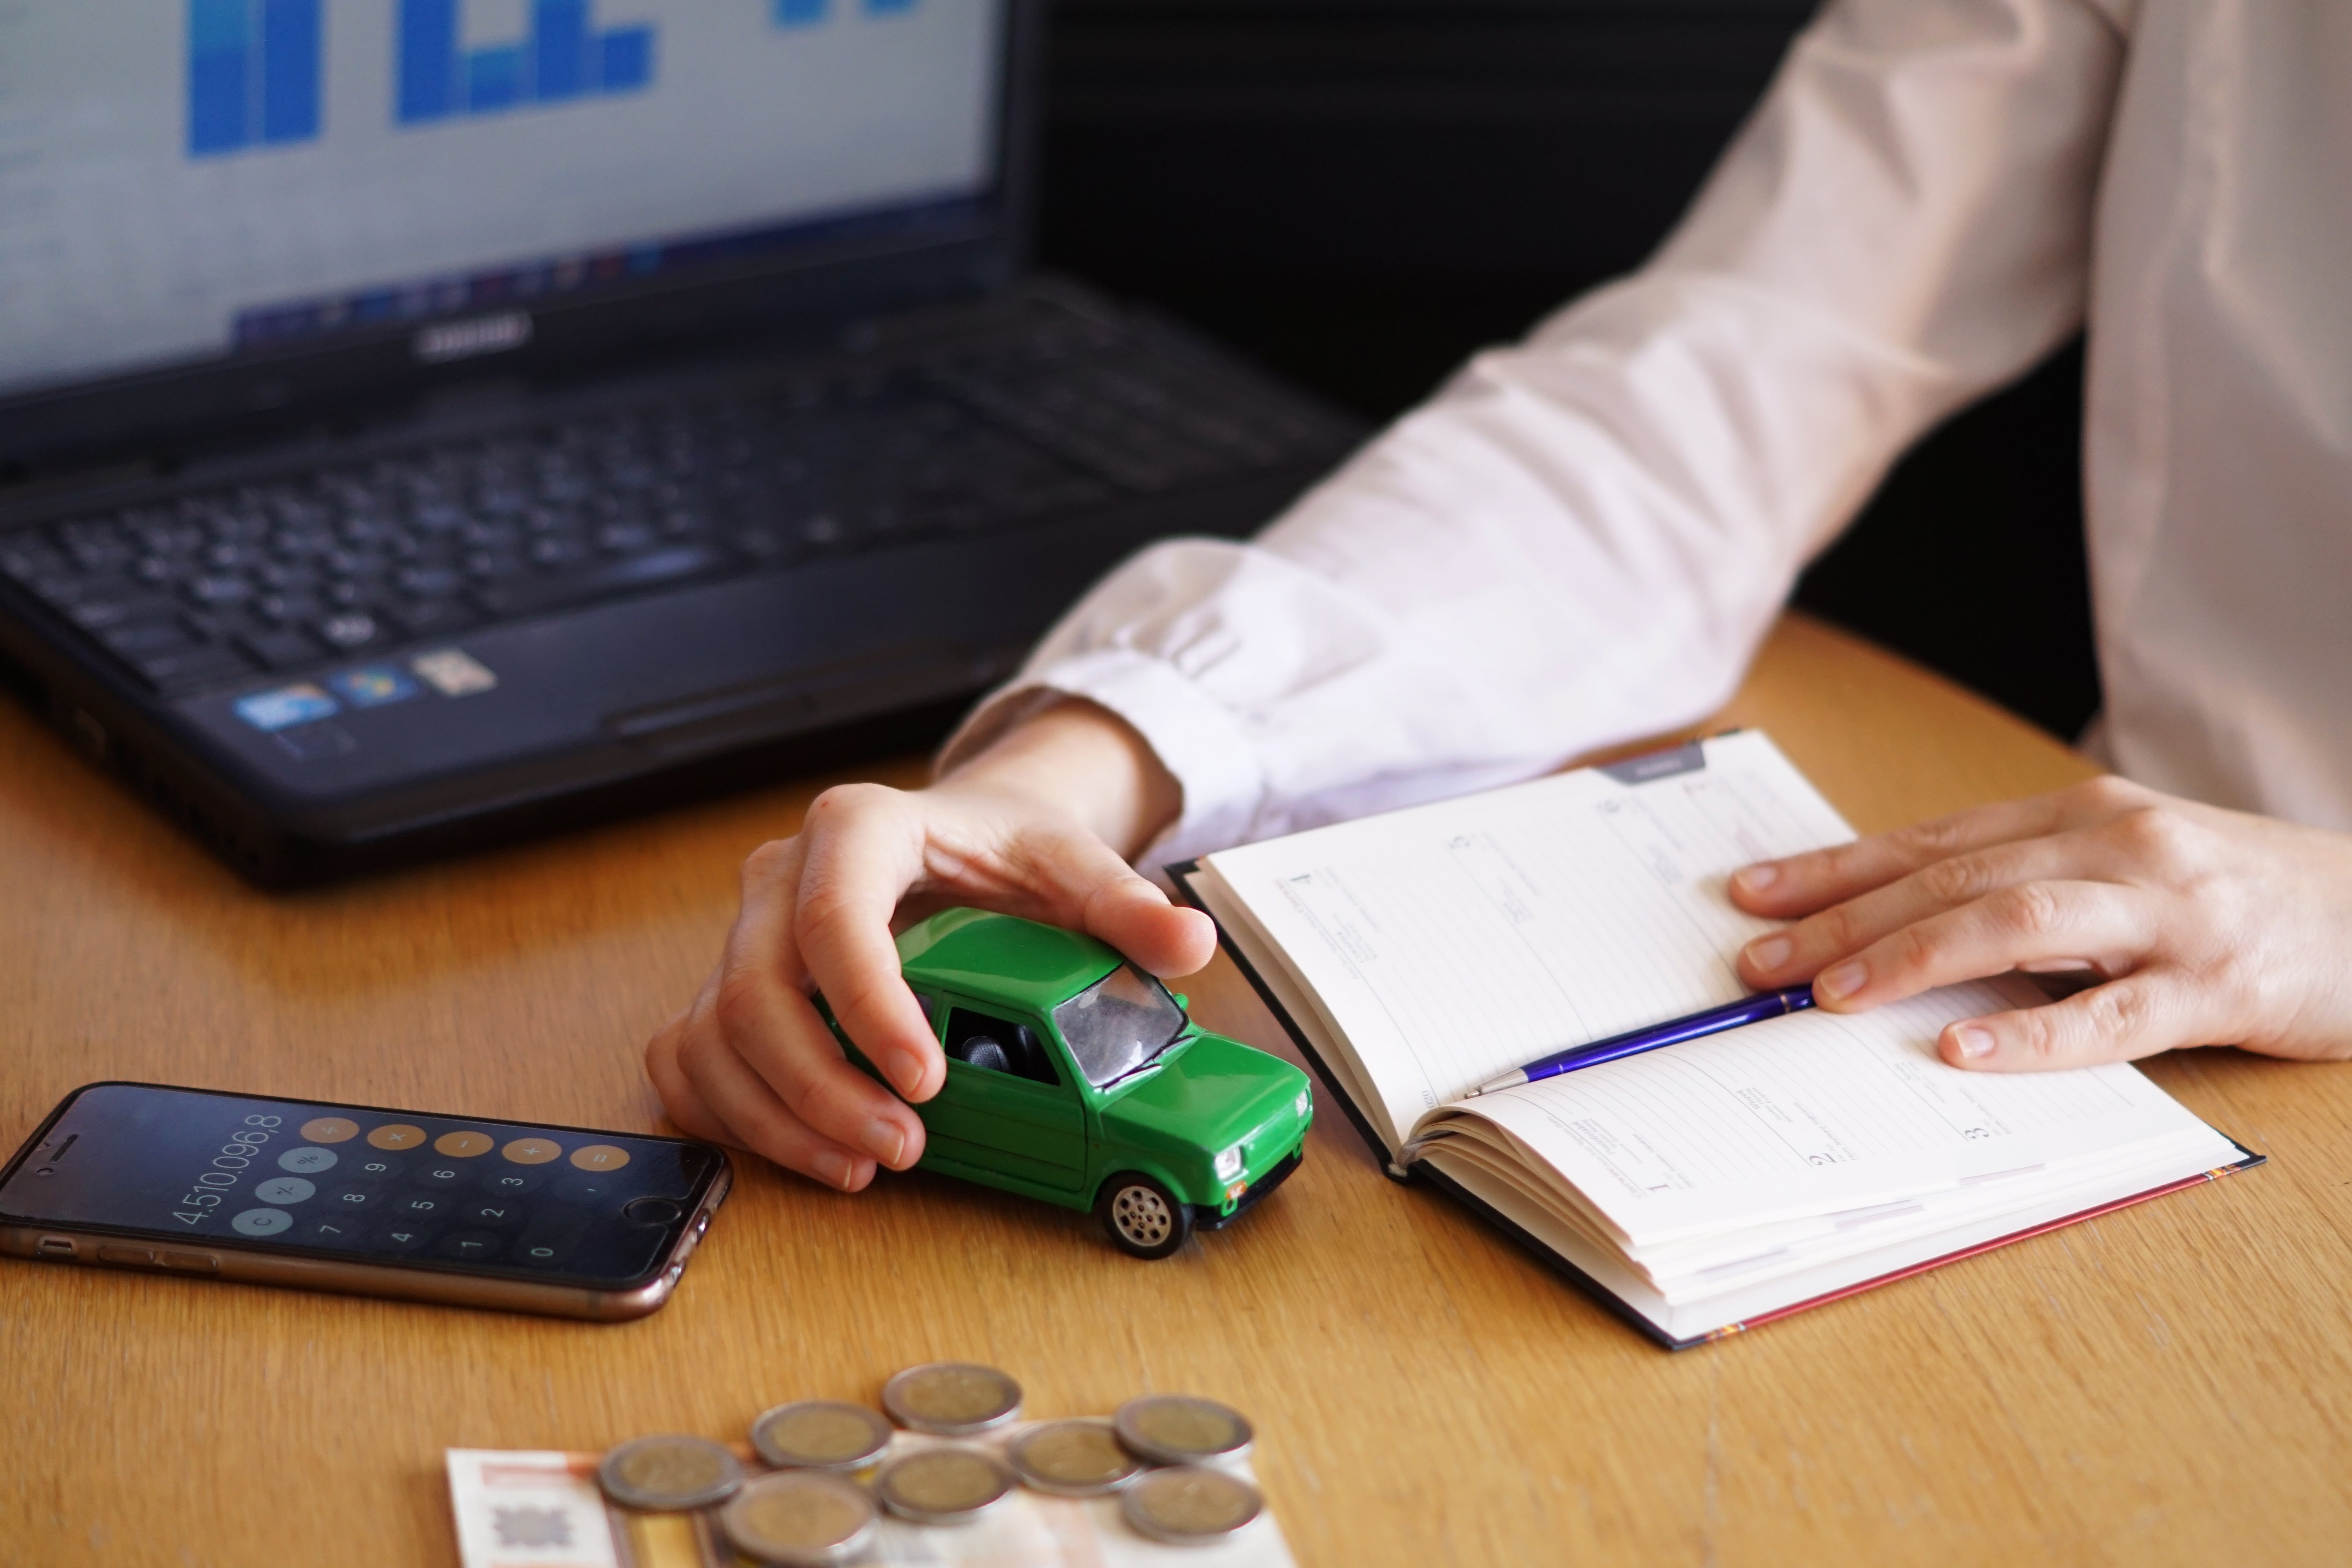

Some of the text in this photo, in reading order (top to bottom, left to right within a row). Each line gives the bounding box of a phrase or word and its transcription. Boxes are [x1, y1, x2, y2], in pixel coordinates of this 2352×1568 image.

[1289, 873, 1311, 885] 4
[1733, 1089, 1763, 1109] Wtorek
[1964, 1127, 1990, 1140] 3
[172, 1114, 282, 1225] 4.510.096,8
[1808, 1152, 1837, 1166] 2
[253, 1218, 272, 1226] C
[297, 1156, 318, 1164] %
[319, 1225, 341, 1233] 7
[343, 1194, 365, 1202] 8
[365, 1163, 387, 1172] 9
[392, 1232, 414, 1242] 4
[411, 1201, 435, 1210] 5
[432, 1170, 455, 1178] 6
[481, 1208, 505, 1217] 2
[501, 1177, 524, 1186] 3
[530, 1247, 554, 1257] 0
